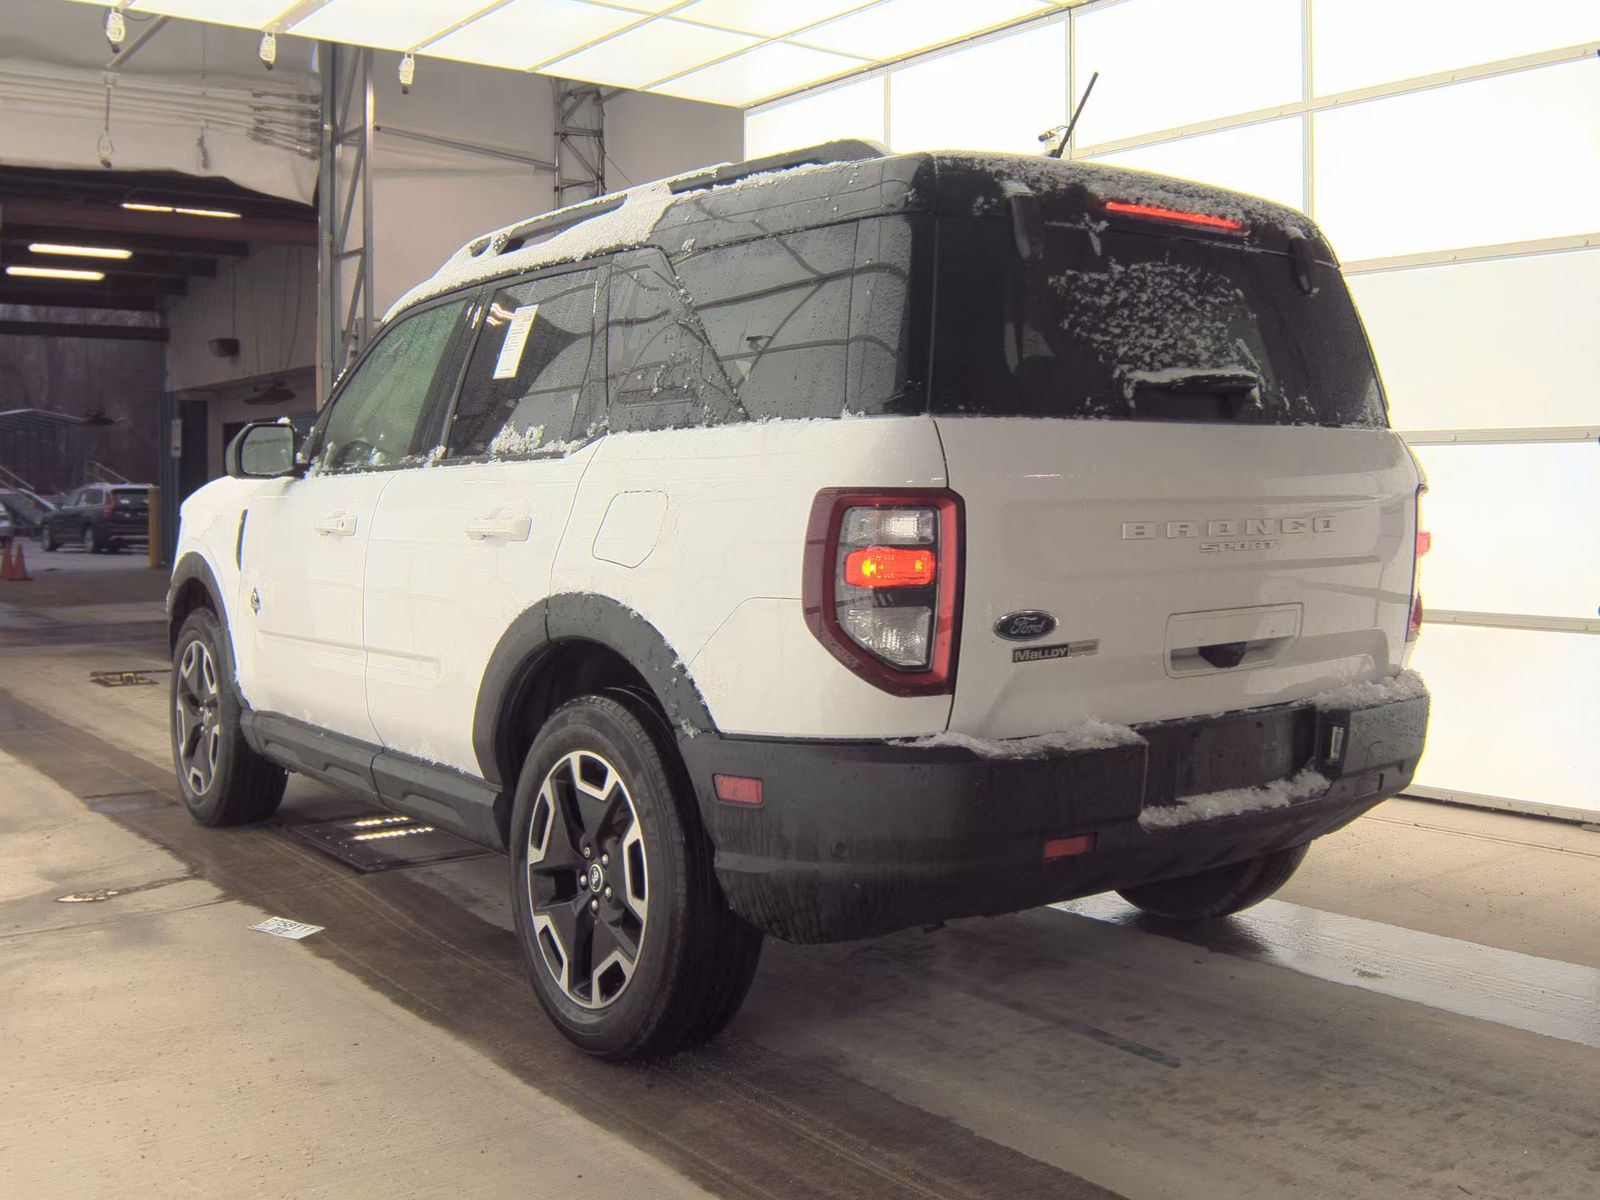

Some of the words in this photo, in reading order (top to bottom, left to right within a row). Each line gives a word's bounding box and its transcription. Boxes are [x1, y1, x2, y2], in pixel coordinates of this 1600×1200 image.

[1121, 516, 1337, 540] BRONCO
[1200, 540, 1280, 553] SPORT
[1010, 616, 1046, 634] Ford
